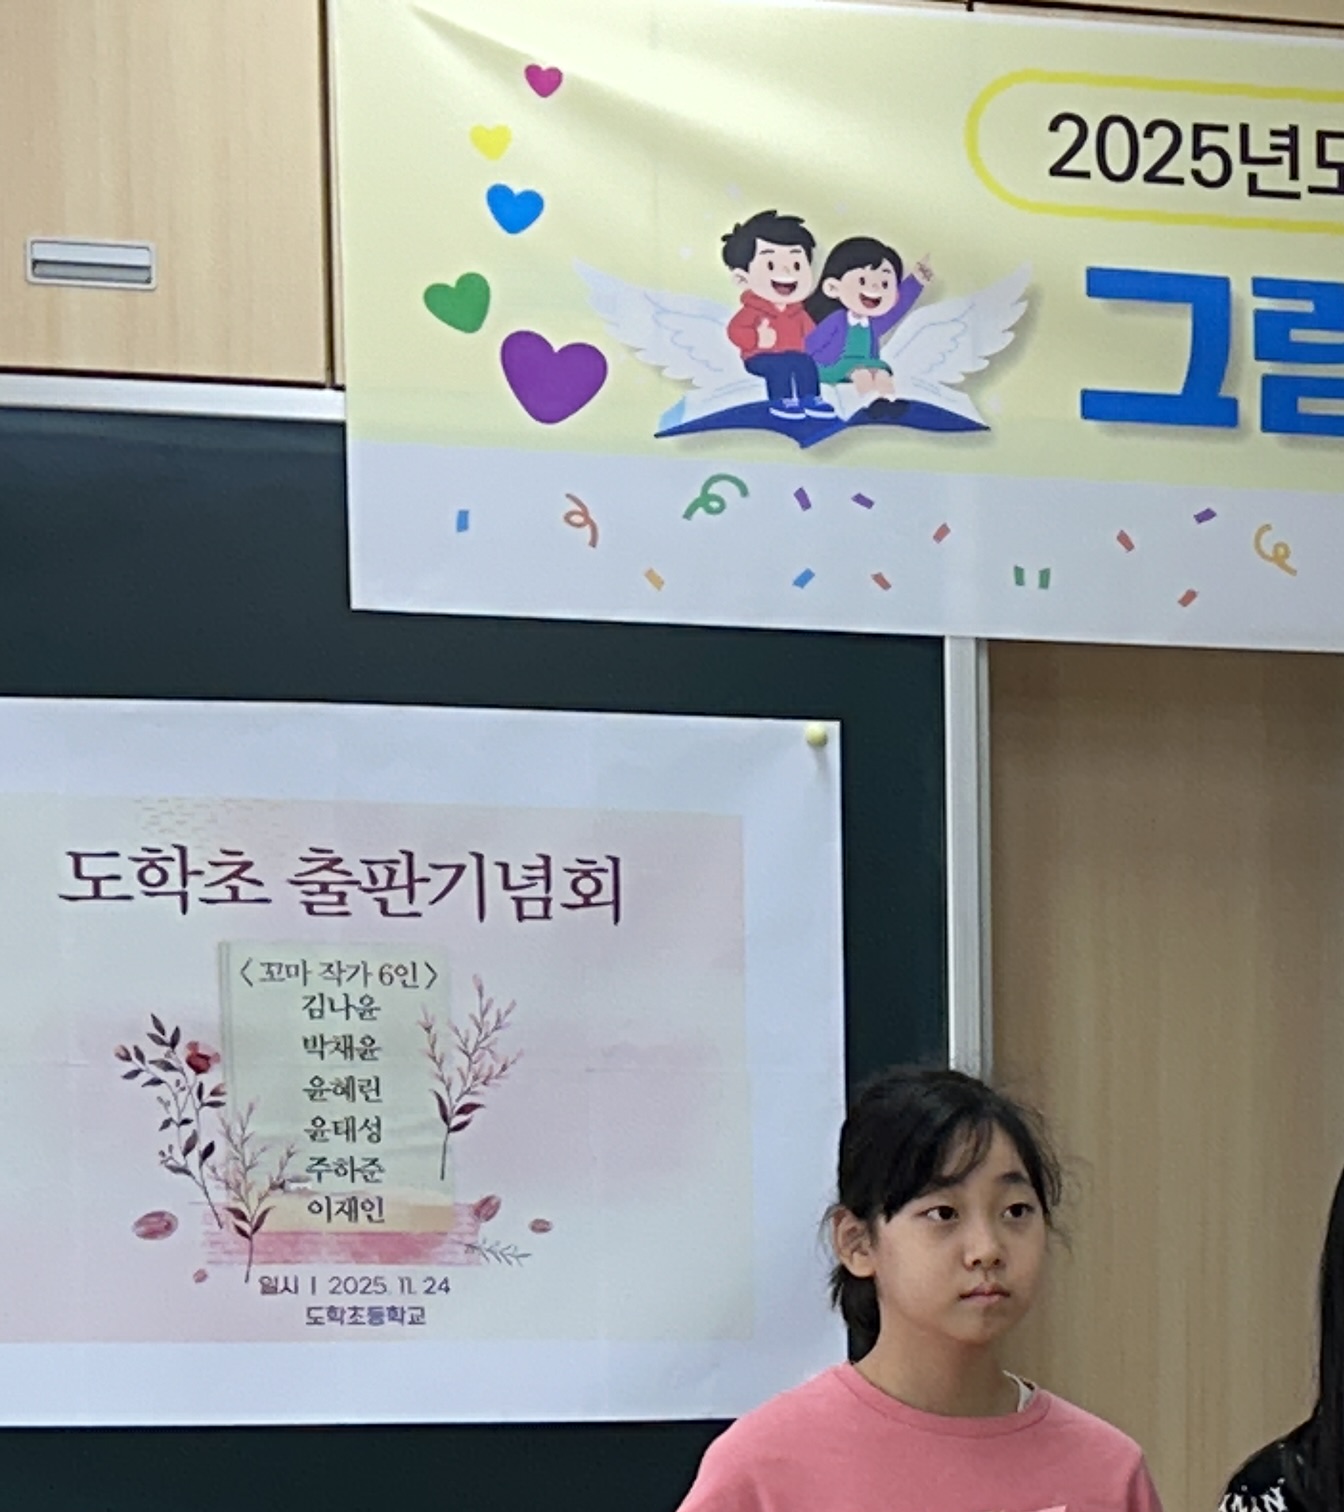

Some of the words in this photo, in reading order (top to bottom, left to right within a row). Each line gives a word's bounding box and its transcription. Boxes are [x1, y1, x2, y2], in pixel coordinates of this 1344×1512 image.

[59, 844, 272, 915] 도학초
[288, 847, 620, 926] 출판기념회
[320, 961, 371, 987] 작가
[303, 993, 381, 1020] 김나윤
[303, 1034, 380, 1061] 박채윤
[303, 1075, 382, 1102] 윤혜린
[304, 1116, 381, 1143] 윤태성
[306, 1156, 384, 1183] 주하준
[308, 1196, 384, 1223] 이재인
[259, 1276, 298, 1295] 일시
[306, 1305, 425, 1326] 도학초등학교
